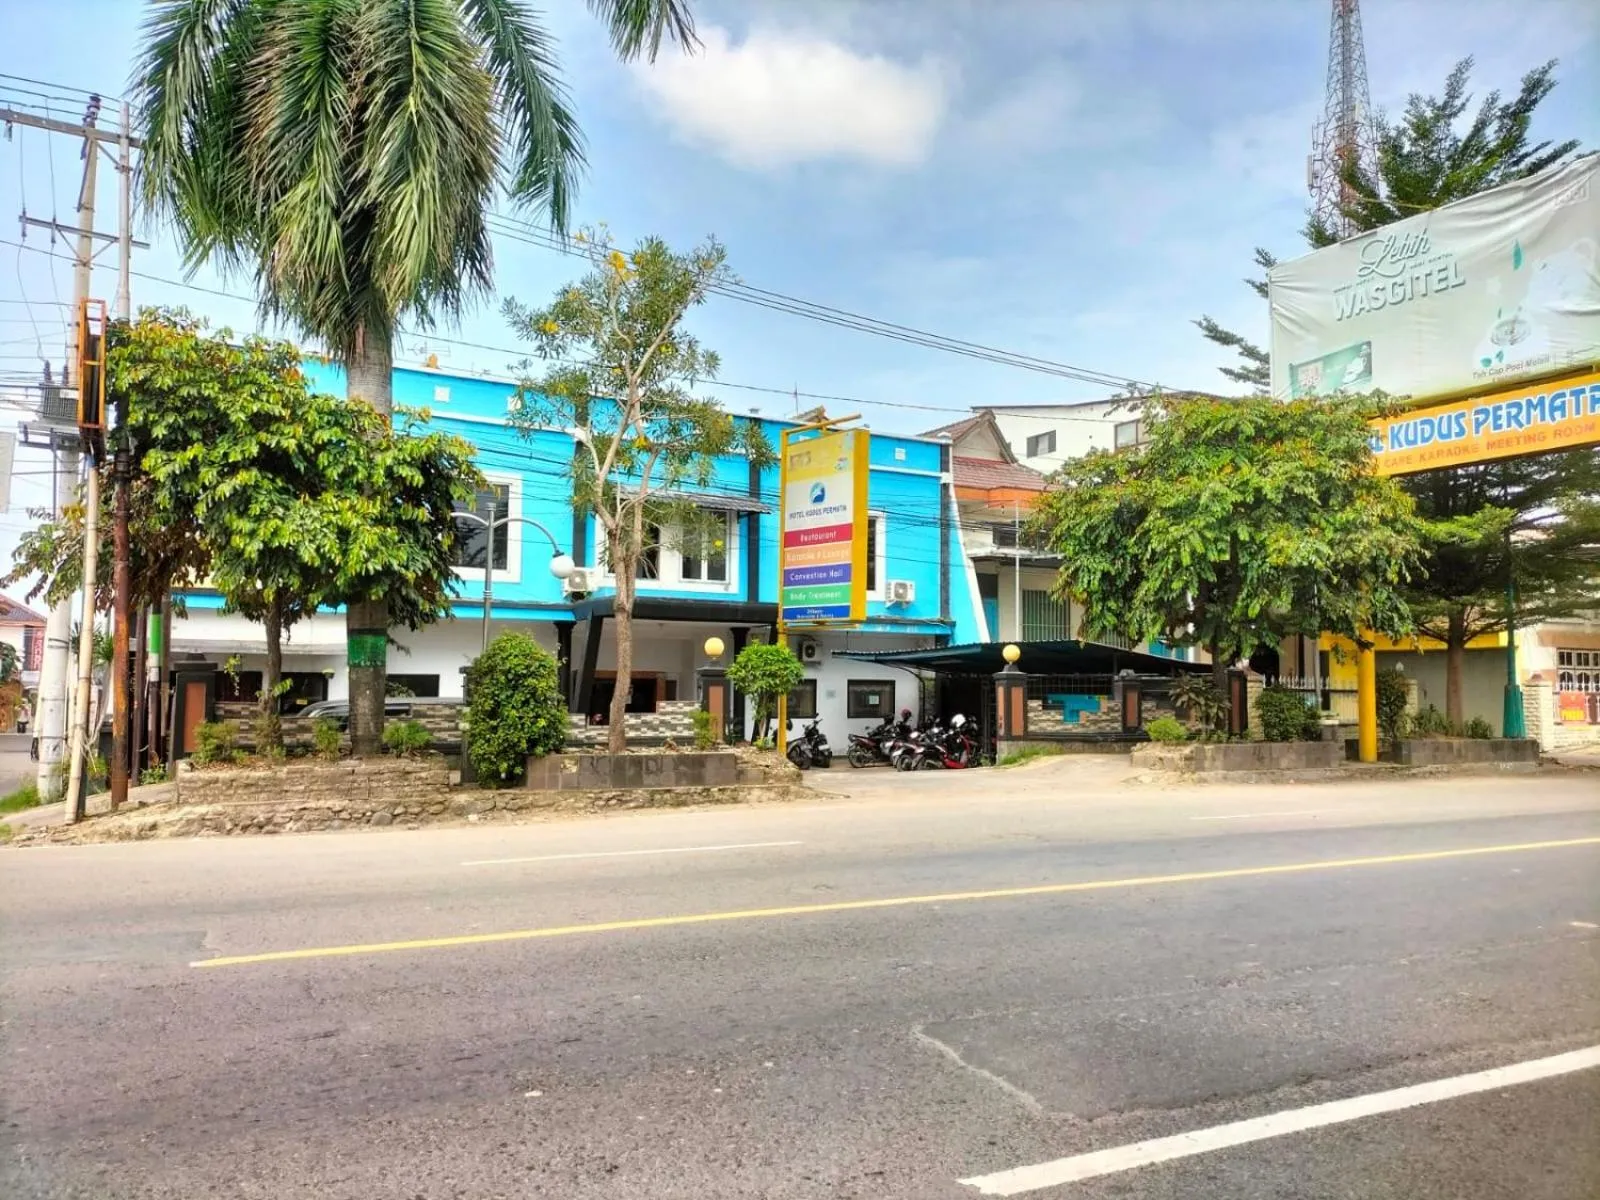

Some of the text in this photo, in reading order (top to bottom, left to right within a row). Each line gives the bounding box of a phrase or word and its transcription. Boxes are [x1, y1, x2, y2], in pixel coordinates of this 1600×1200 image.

[1332, 261, 1466, 322] WASGITEL
[1389, 411, 1467, 450] KUDUS
[1419, 442, 1481, 462] KARAOKE
[1486, 430, 1547, 451] MEETING
[1553, 422, 1596, 440] ROOM
[829, 569, 844, 578] Hall
